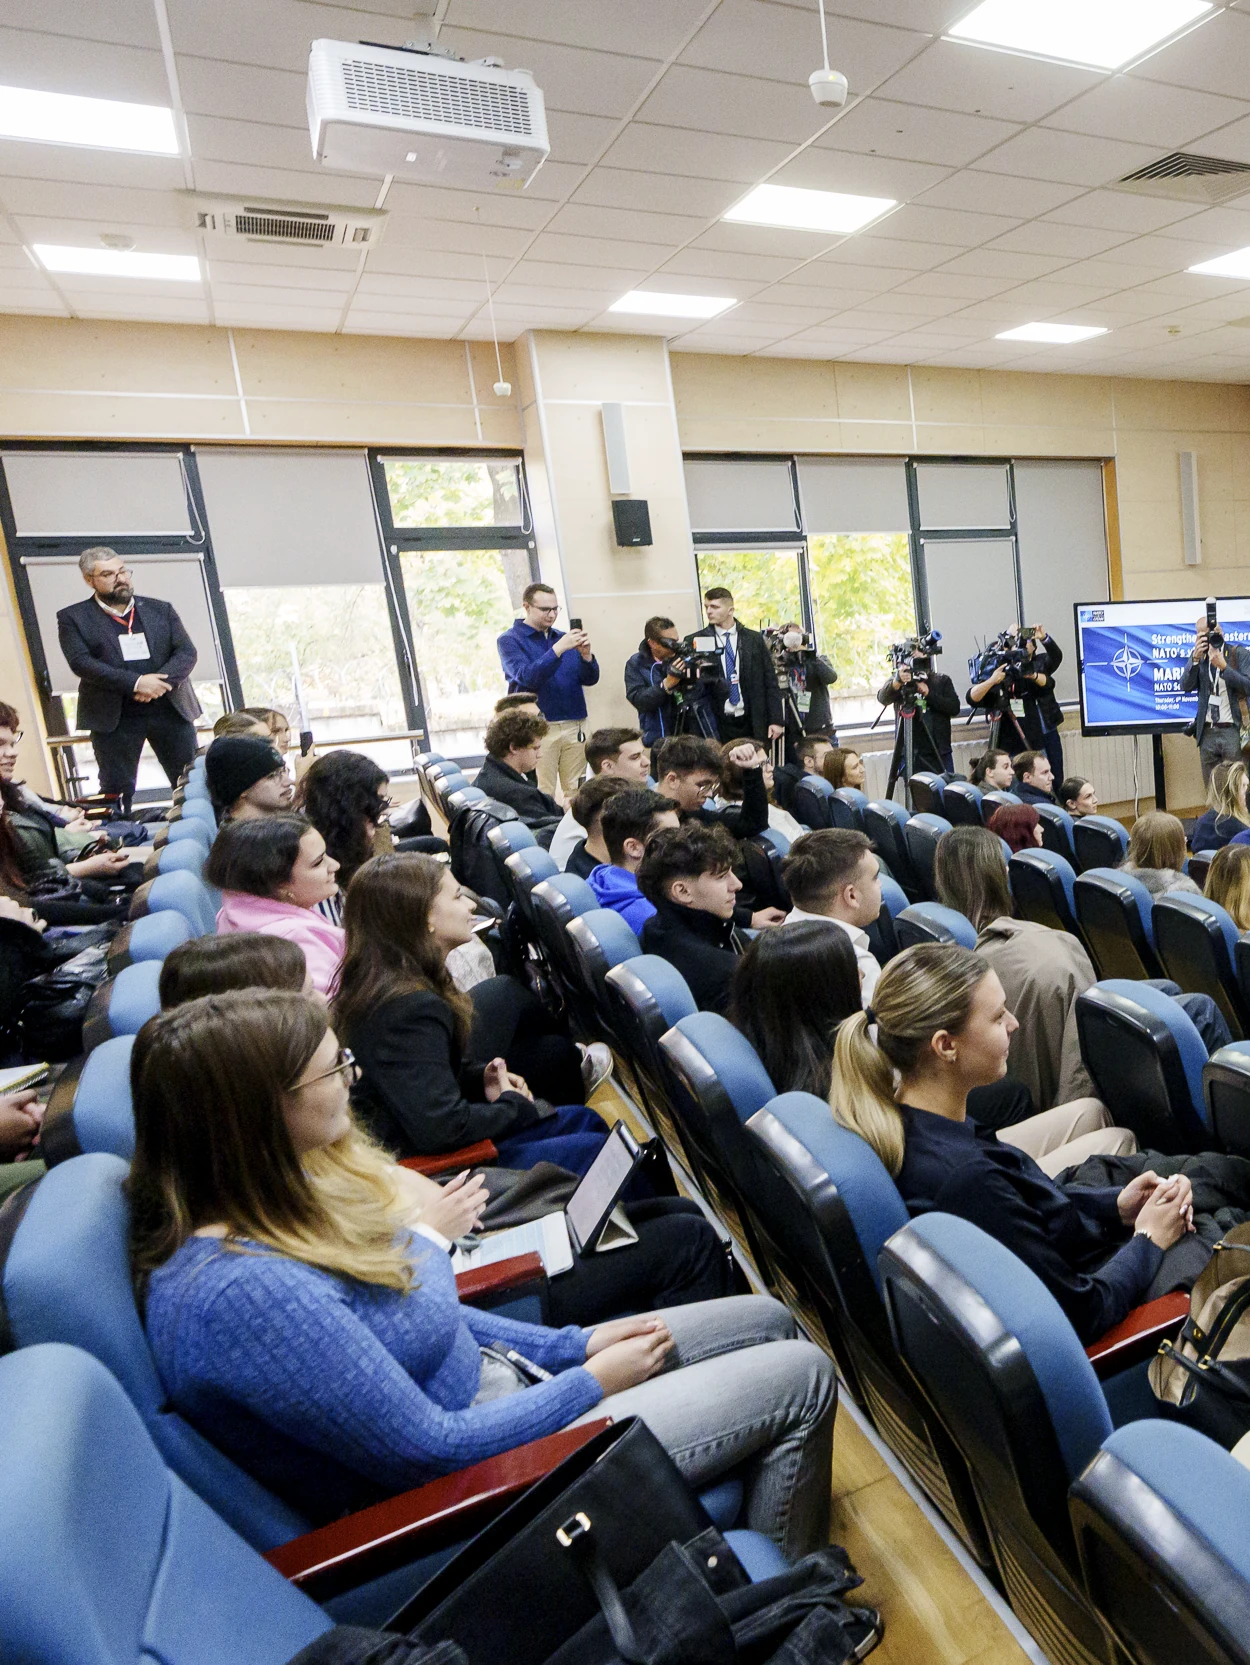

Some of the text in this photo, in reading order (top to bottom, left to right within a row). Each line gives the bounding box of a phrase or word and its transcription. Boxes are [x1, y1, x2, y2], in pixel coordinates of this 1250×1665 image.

[1151, 632, 1198, 646] Strengthe
[1152, 646, 1186, 659] NATO's
[1154, 682, 1173, 692] NATO
